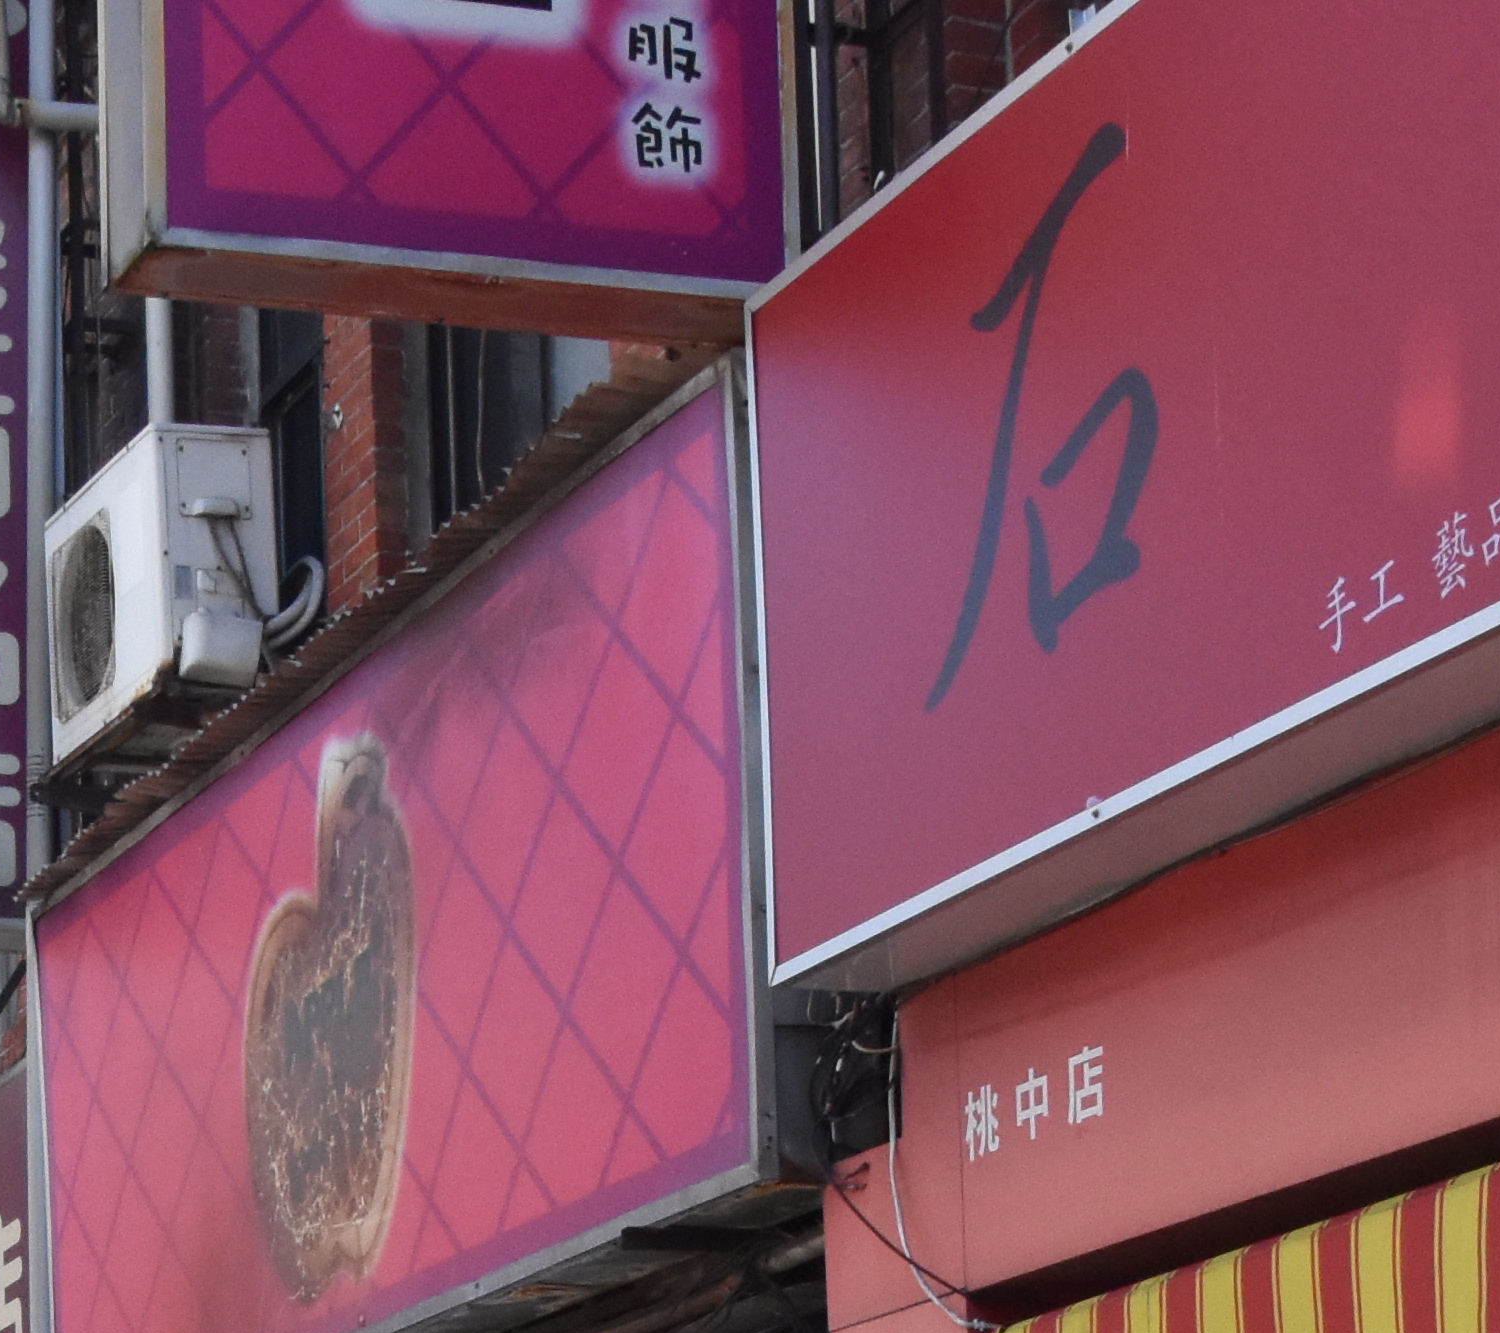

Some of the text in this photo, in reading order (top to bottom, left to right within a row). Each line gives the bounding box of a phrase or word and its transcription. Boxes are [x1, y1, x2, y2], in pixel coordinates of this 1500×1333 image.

[625, 15, 704, 174] 服飾
[1319, 560, 1405, 654] 手工
[964, 1046, 1105, 1163] 桃中店
